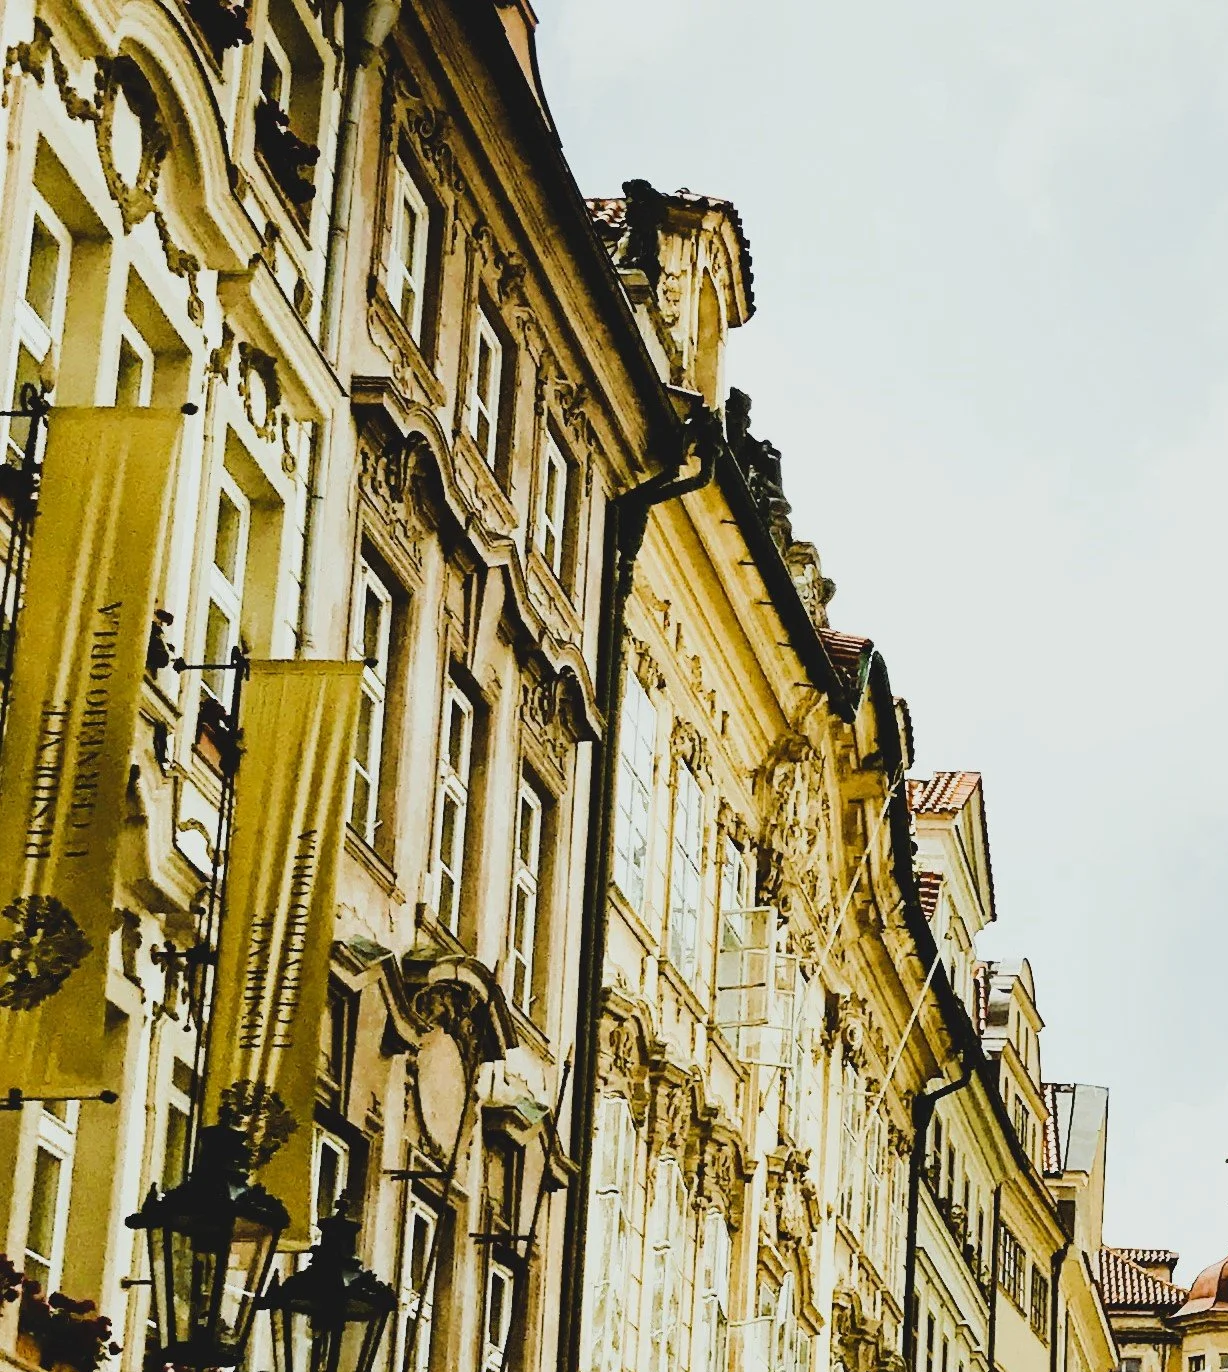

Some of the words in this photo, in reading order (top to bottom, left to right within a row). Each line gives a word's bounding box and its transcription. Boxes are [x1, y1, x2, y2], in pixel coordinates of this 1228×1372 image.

[88, 601, 123, 681] ORLA
[25, 699, 72, 859] RESIDENCE
[291, 828, 318, 897] ORLA
